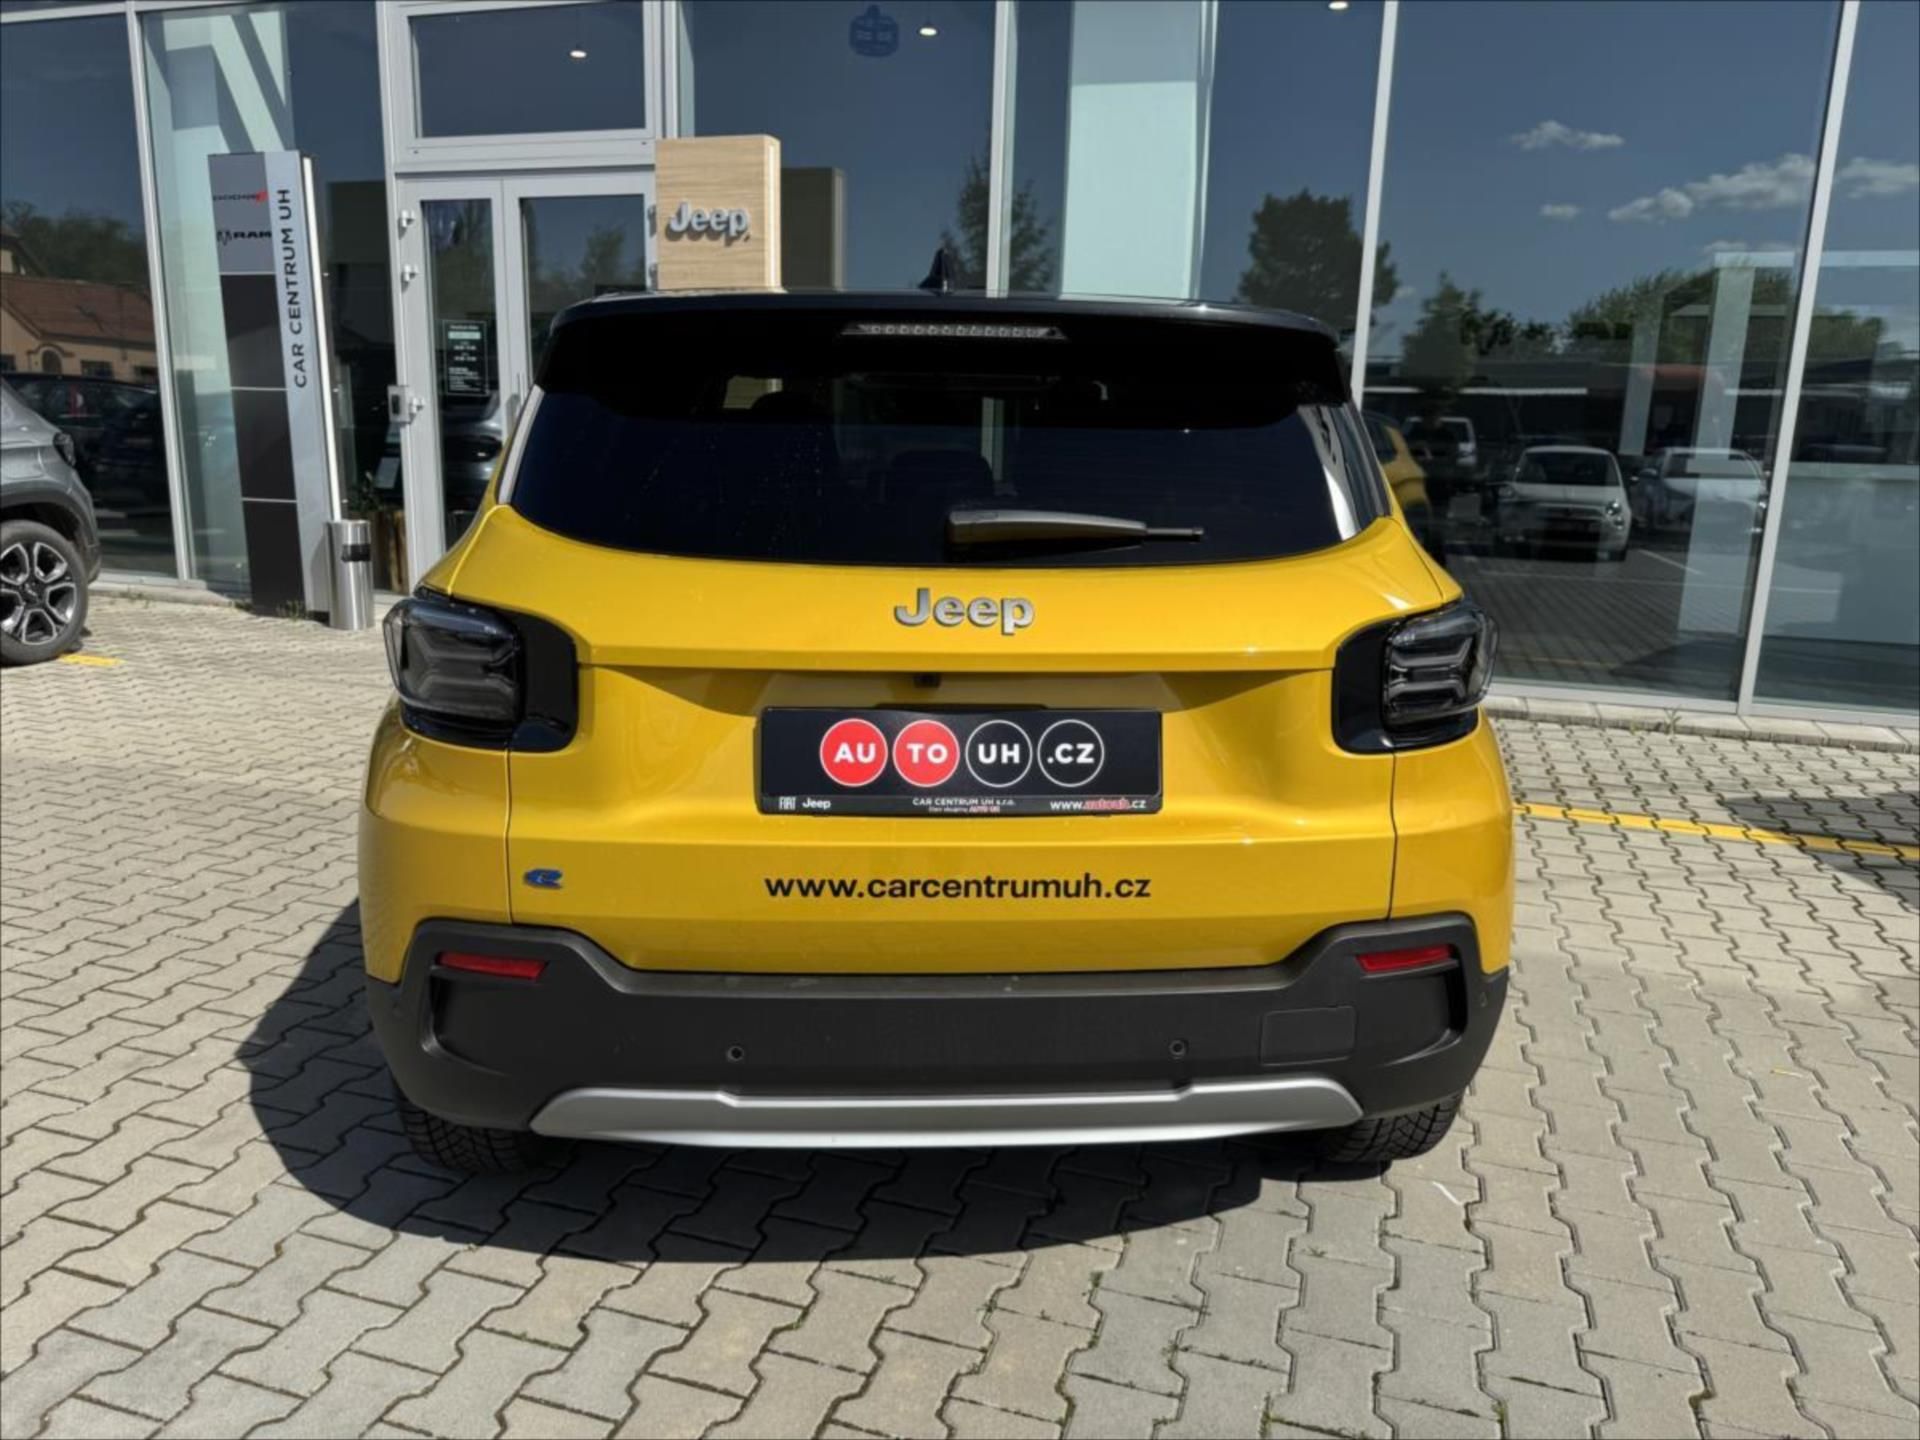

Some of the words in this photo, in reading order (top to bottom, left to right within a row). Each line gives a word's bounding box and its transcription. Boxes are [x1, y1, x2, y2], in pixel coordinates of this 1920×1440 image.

[276, 189, 292, 220] UH
[669, 200, 749, 238] Jeep
[233, 230, 272, 239] RAM
[280, 228, 303, 335] CENTRUM
[291, 343, 307, 388] CAR
[893, 587, 1035, 636] Jeep
[833, 742, 877, 764] AU
[906, 743, 949, 764] TO
[977, 743, 1021, 764] UH
[1046, 743, 1095, 764] .CZ
[802, 797, 832, 810] Jeep
[912, 798, 932, 806] CAR
[934, 798, 979, 806] CENTRUM
[764, 872, 1152, 899] www.carcentrumuh.cz
